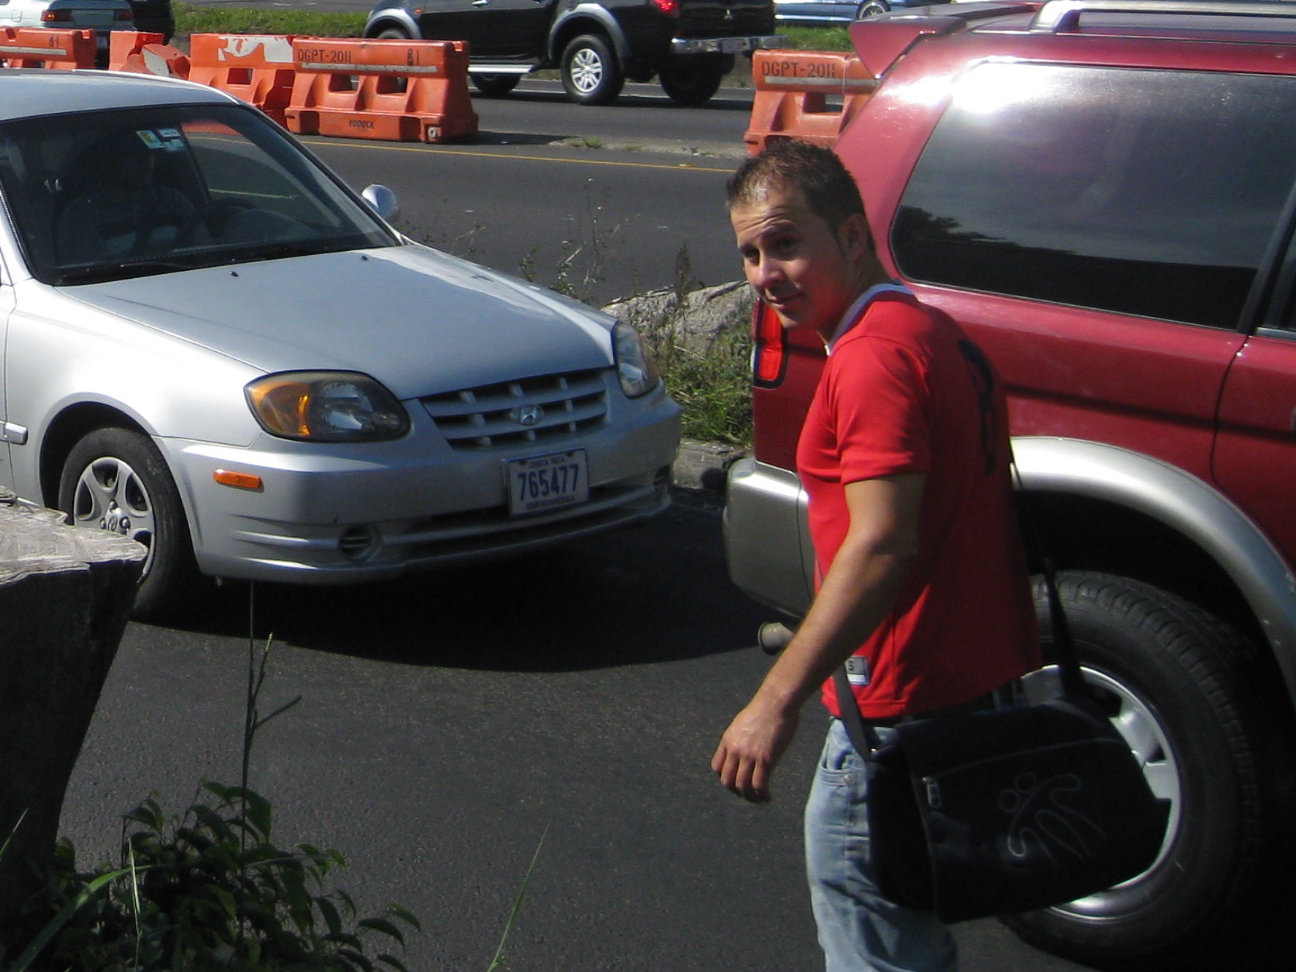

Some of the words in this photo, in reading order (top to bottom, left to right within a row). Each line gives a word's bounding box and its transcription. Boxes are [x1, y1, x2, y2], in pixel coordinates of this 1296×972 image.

[297, 48, 353, 65] DGPT-2011
[761, 61, 837, 78] DGPT-2011
[517, 463, 579, 501] 765477
